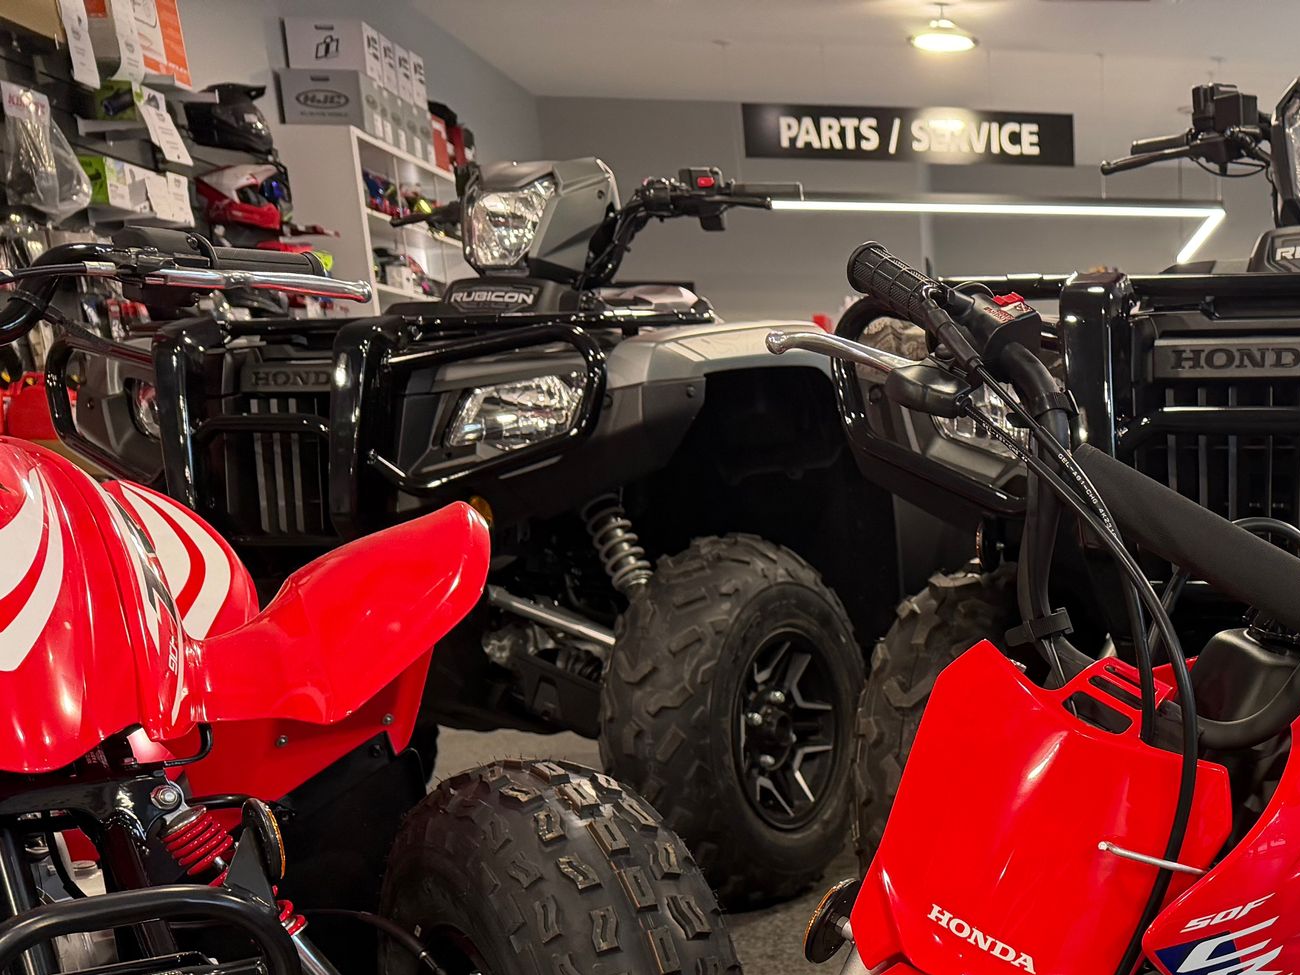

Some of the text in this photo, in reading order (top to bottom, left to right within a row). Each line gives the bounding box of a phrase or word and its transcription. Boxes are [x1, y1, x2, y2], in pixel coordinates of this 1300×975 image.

[301, 93, 343, 106] HJC
[778, 116, 1041, 155] PARTS / SERVICE
[450, 291, 534, 304] RUBICON
[251, 370, 332, 387] HOND
[1179, 893, 1276, 933] 50F
[927, 903, 1037, 975] HONDA
